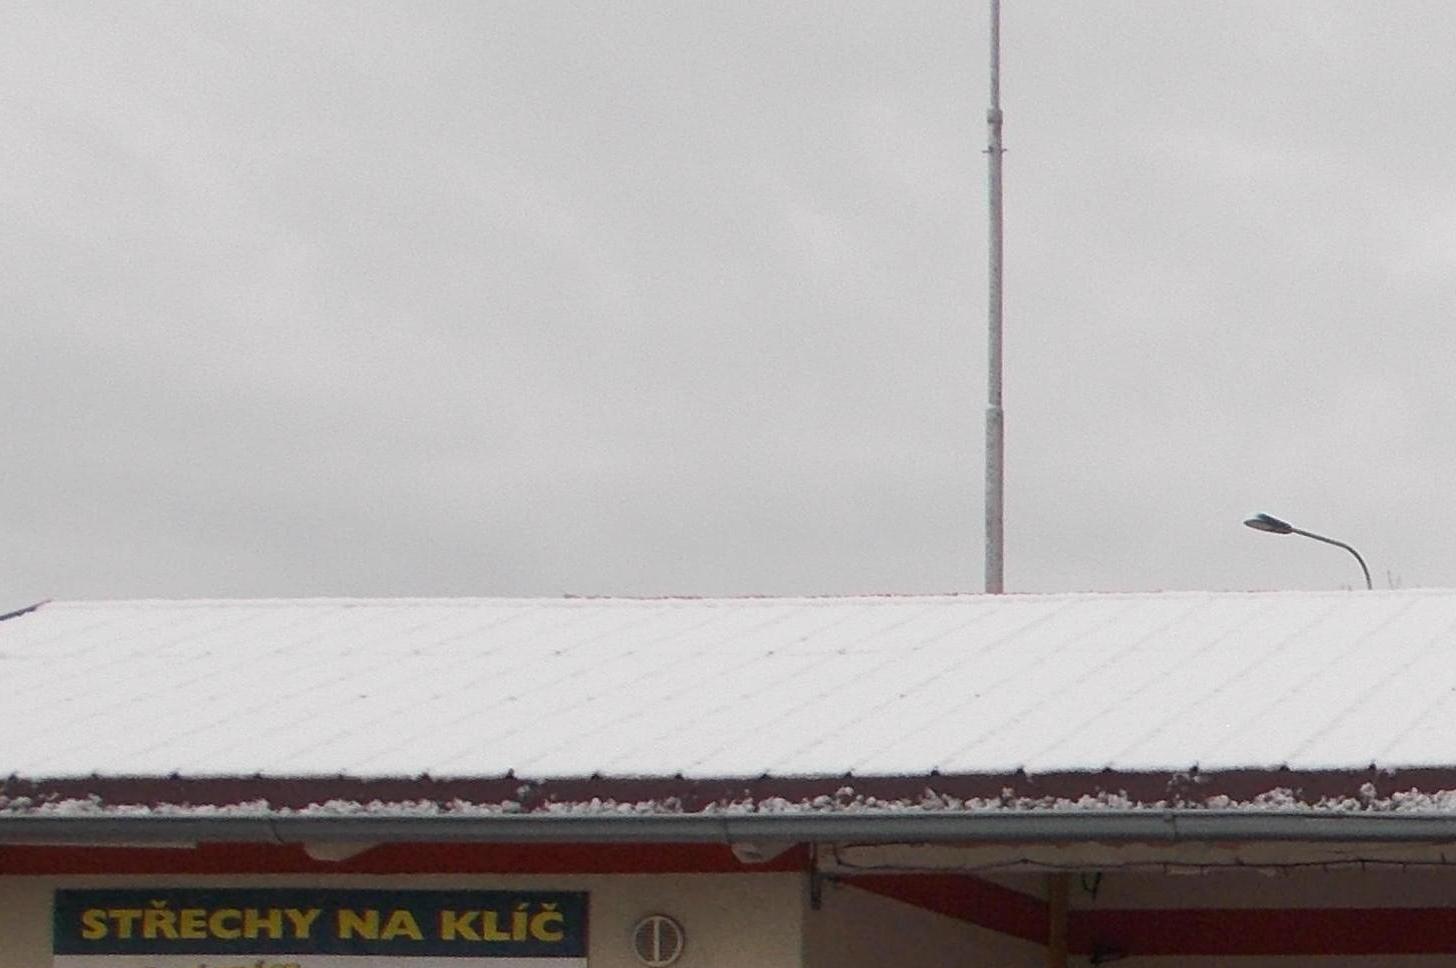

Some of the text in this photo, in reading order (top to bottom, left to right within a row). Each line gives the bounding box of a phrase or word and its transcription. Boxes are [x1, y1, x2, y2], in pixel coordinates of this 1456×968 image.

[81, 900, 566, 942] STŘECHY NA KLÍČ
